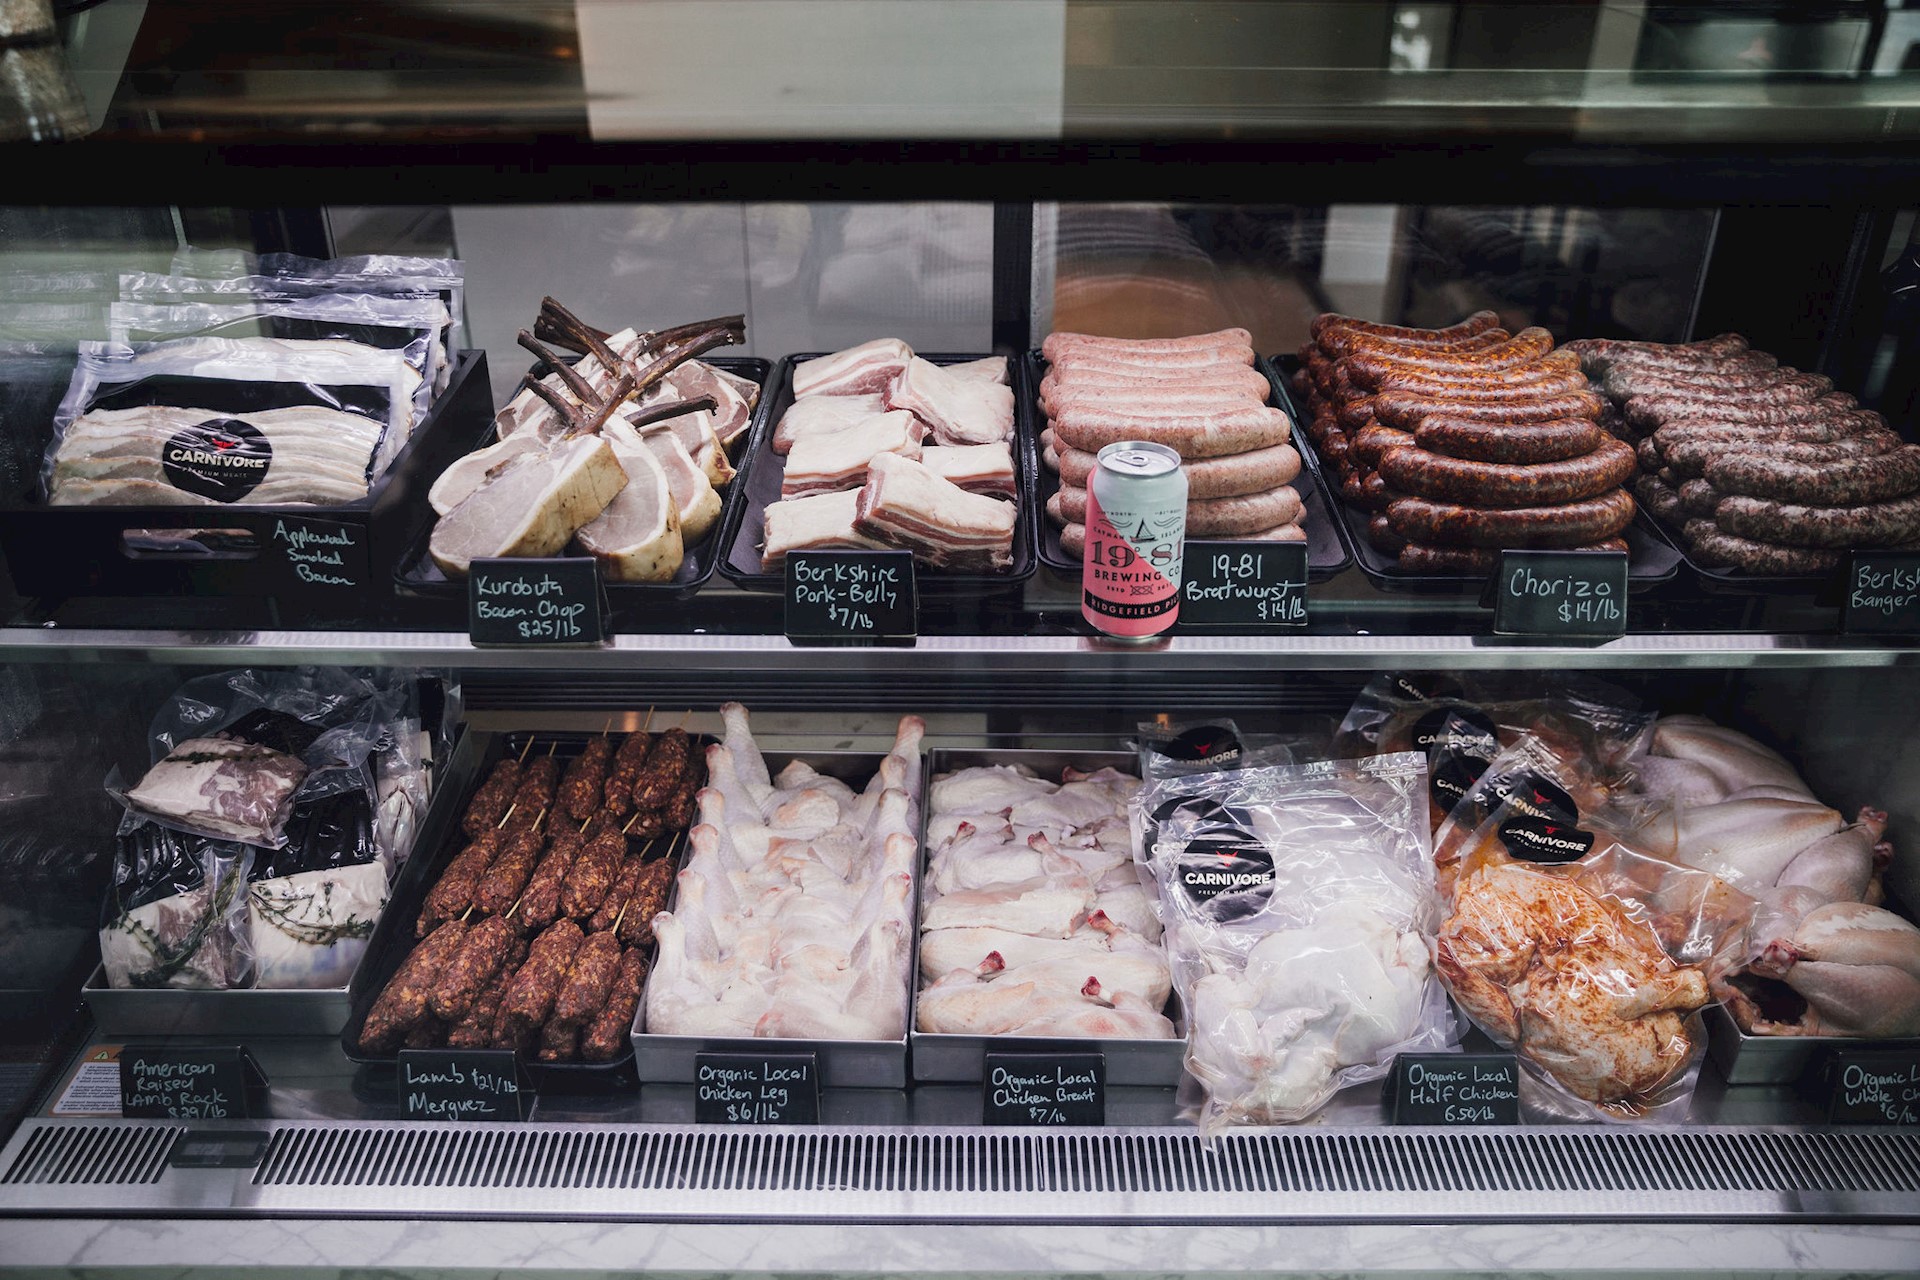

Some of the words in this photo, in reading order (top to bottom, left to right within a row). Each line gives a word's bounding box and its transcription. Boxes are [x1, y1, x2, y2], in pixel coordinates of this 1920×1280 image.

[170, 449, 266, 469] CARNIVORE
[273, 519, 356, 549] Applewood
[1093, 526, 1125, 540] CAYMAN
[286, 547, 344, 566] Smoked
[1212, 553, 1262, 580] 19-81
[296, 563, 356, 586] Bacon
[795, 559, 899, 583] Berkshire
[1094, 569, 1162, 582] BREWING
[1510, 567, 1611, 597] Chorizo
[795, 580, 897, 609] Pork-Belly
[1186, 579, 1307, 602] Bratwurst
[1091, 598, 1161, 616] RIDGEFIELD
[1257, 595, 1306, 620] $14/lb
[1557, 598, 1620, 623] $14/lb
[1851, 589, 1918, 616] Banger
[828, 603, 874, 630] $7/lb
[518, 619, 581, 640] $25/lb
[1505, 827, 1586, 853] CARNIVORE
[1184, 872, 1272, 886] CARNIVORE
[133, 1058, 216, 1078] American
[406, 1062, 465, 1084] Lamb
[699, 1064, 758, 1088] Organic
[763, 1061, 807, 1082] Local
[1408, 1063, 1467, 1090] Organic
[1472, 1065, 1512, 1083] Local
[1843, 1064, 1907, 1094] Organic
[136, 1076, 195, 1092] Raised
[991, 1067, 1054, 1093] Organic
[1057, 1066, 1097, 1086] Local
[180, 1087, 229, 1106] Rack
[699, 1085, 752, 1101] Chicken
[760, 1085, 788, 1107] Leg
[993, 1088, 1052, 1107] Chicken
[1055, 1087, 1096, 1103] Breast
[1410, 1085, 1455, 1104] Half
[1459, 1085, 1519, 1101] Chicken
[1845, 1088, 1893, 1106] Whole
[408, 1091, 497, 1121] Merguez
[726, 1102, 780, 1124] $6/lb
[1028, 1106, 1067, 1124] $7/lb
[1444, 1104, 1495, 1122] 6.50/lb
[1879, 1102, 1918, 1126] $6/lb
